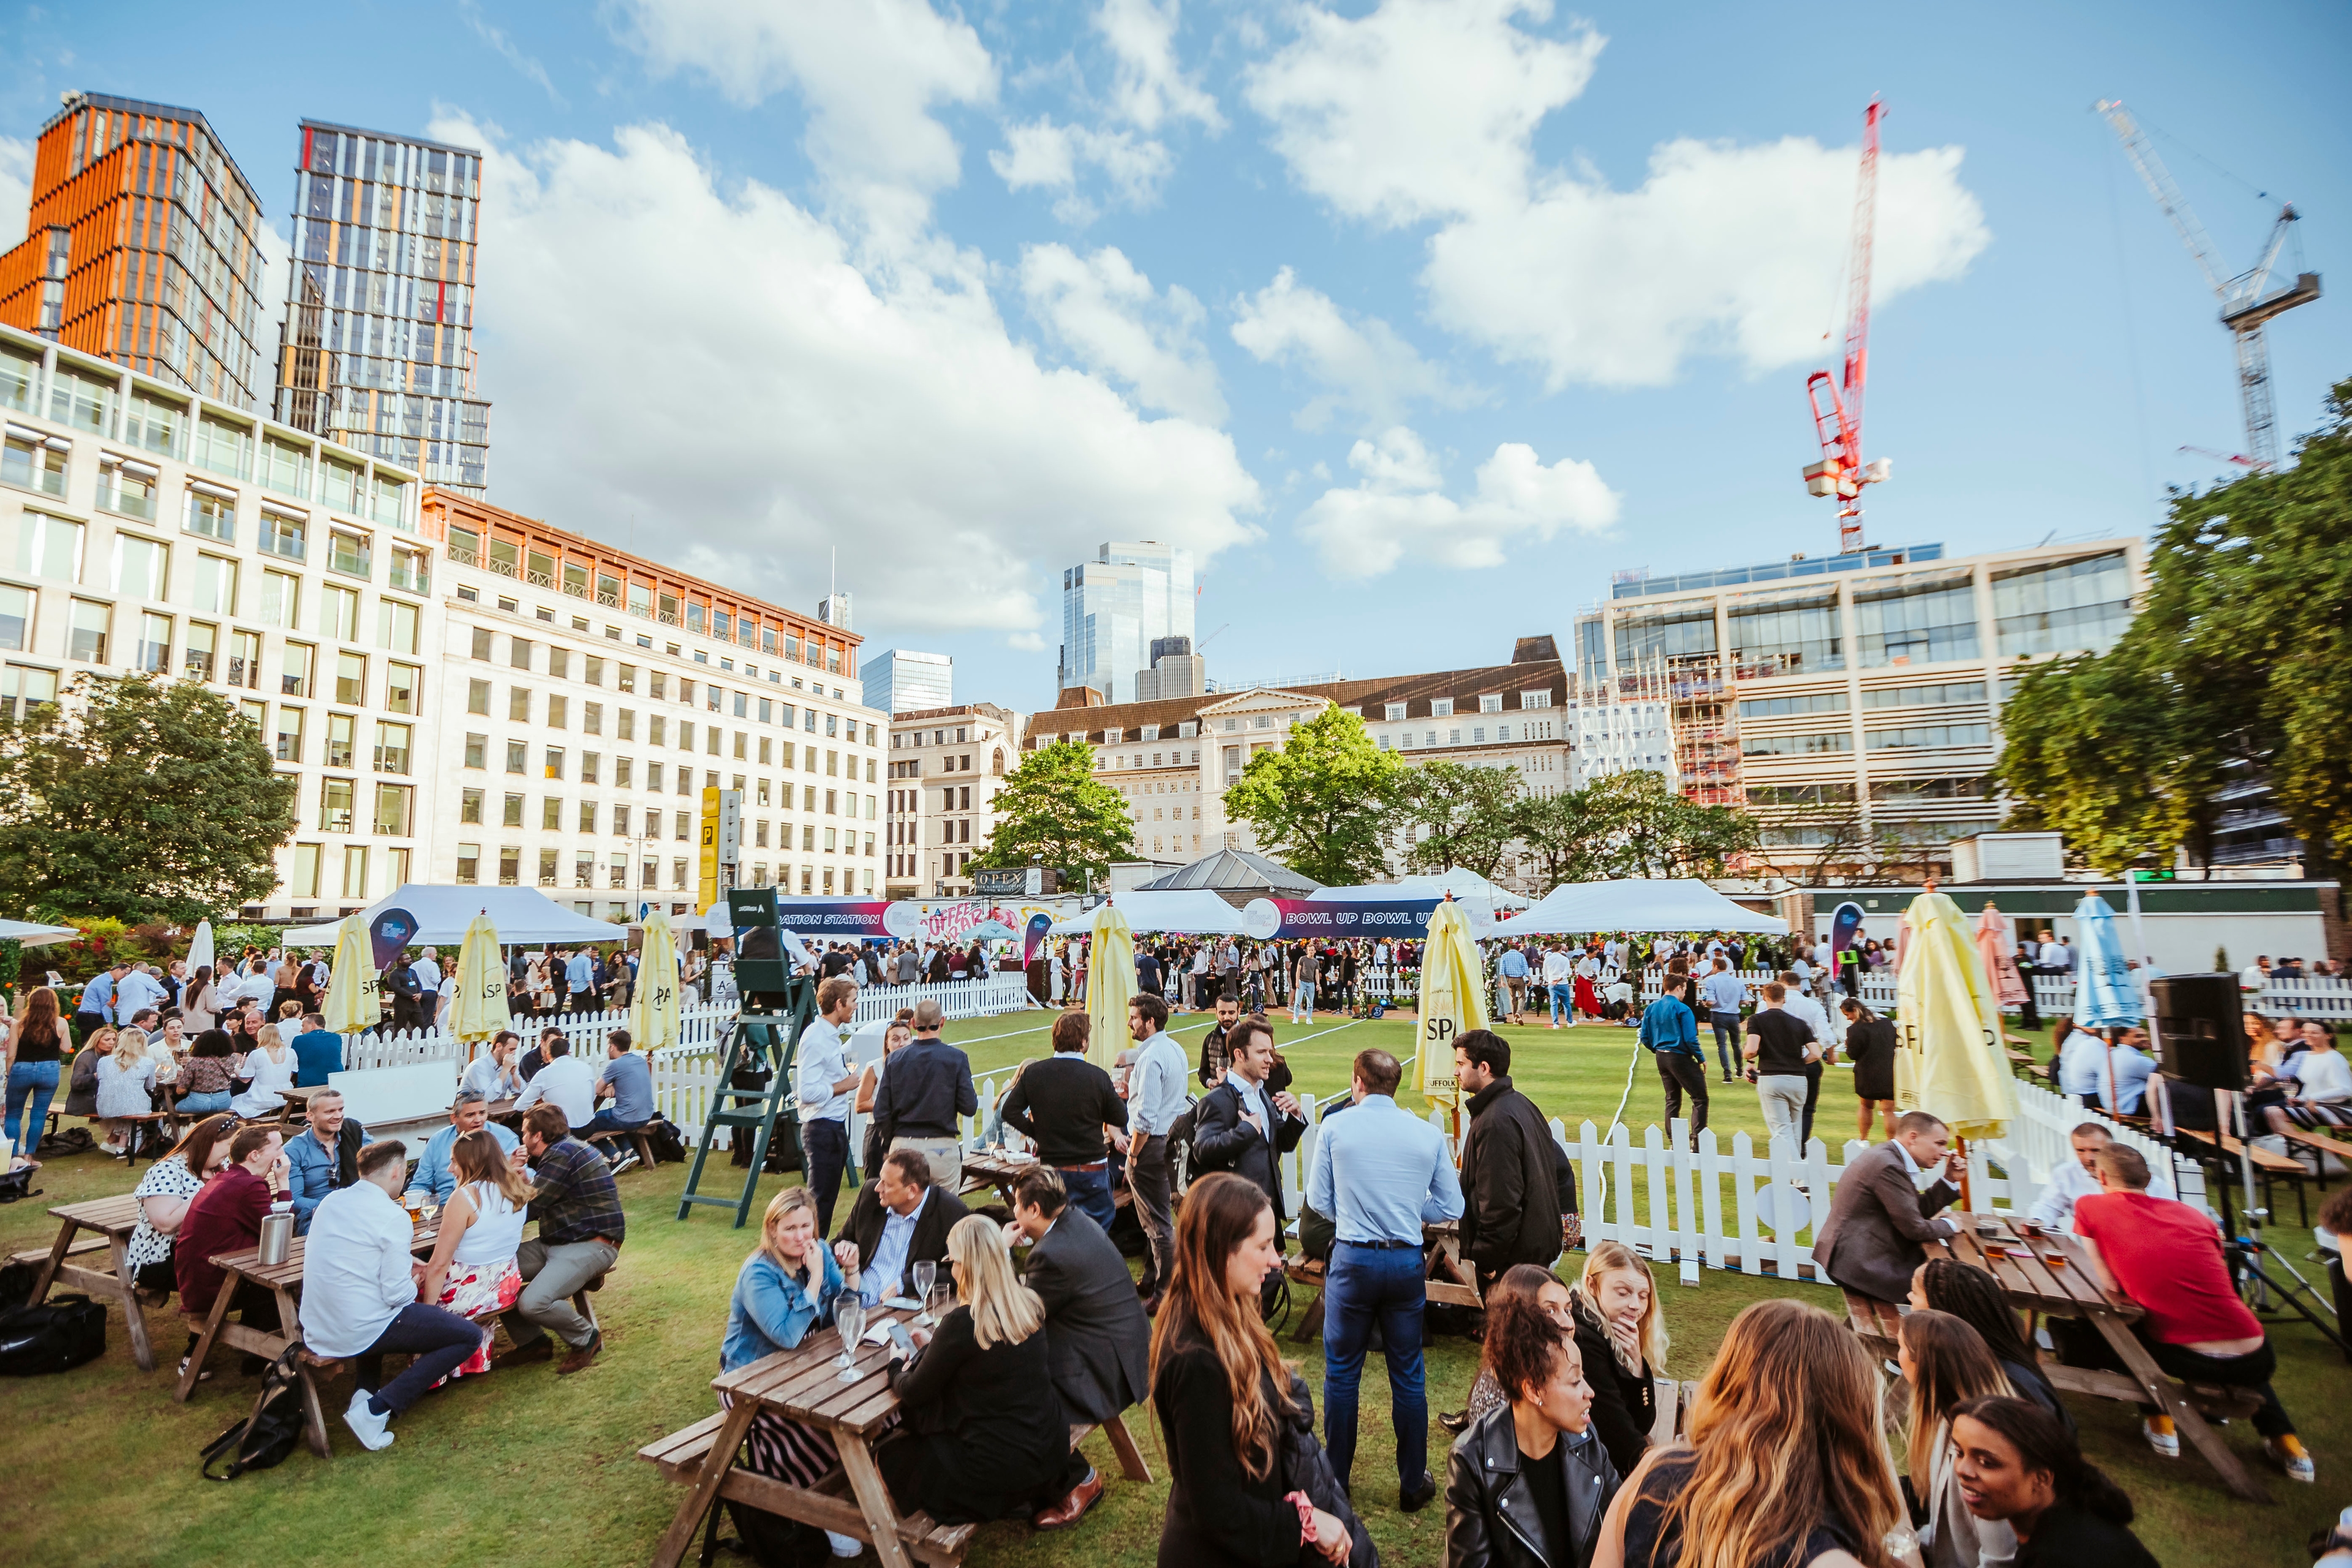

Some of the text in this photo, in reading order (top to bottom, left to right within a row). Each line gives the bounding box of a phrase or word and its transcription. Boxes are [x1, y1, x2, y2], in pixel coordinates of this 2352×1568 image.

[704, 827, 711, 844] P
[979, 873, 1021, 884] OPEN
[823, 914, 880, 925] STATION
[1286, 913, 1332, 924] BOWL
[1336, 913, 1358, 924] UP
[1362, 913, 1411, 924] BOWL
[1254, 1004, 1264, 1013] 4
[1373, 1007, 1382, 1017] 3
